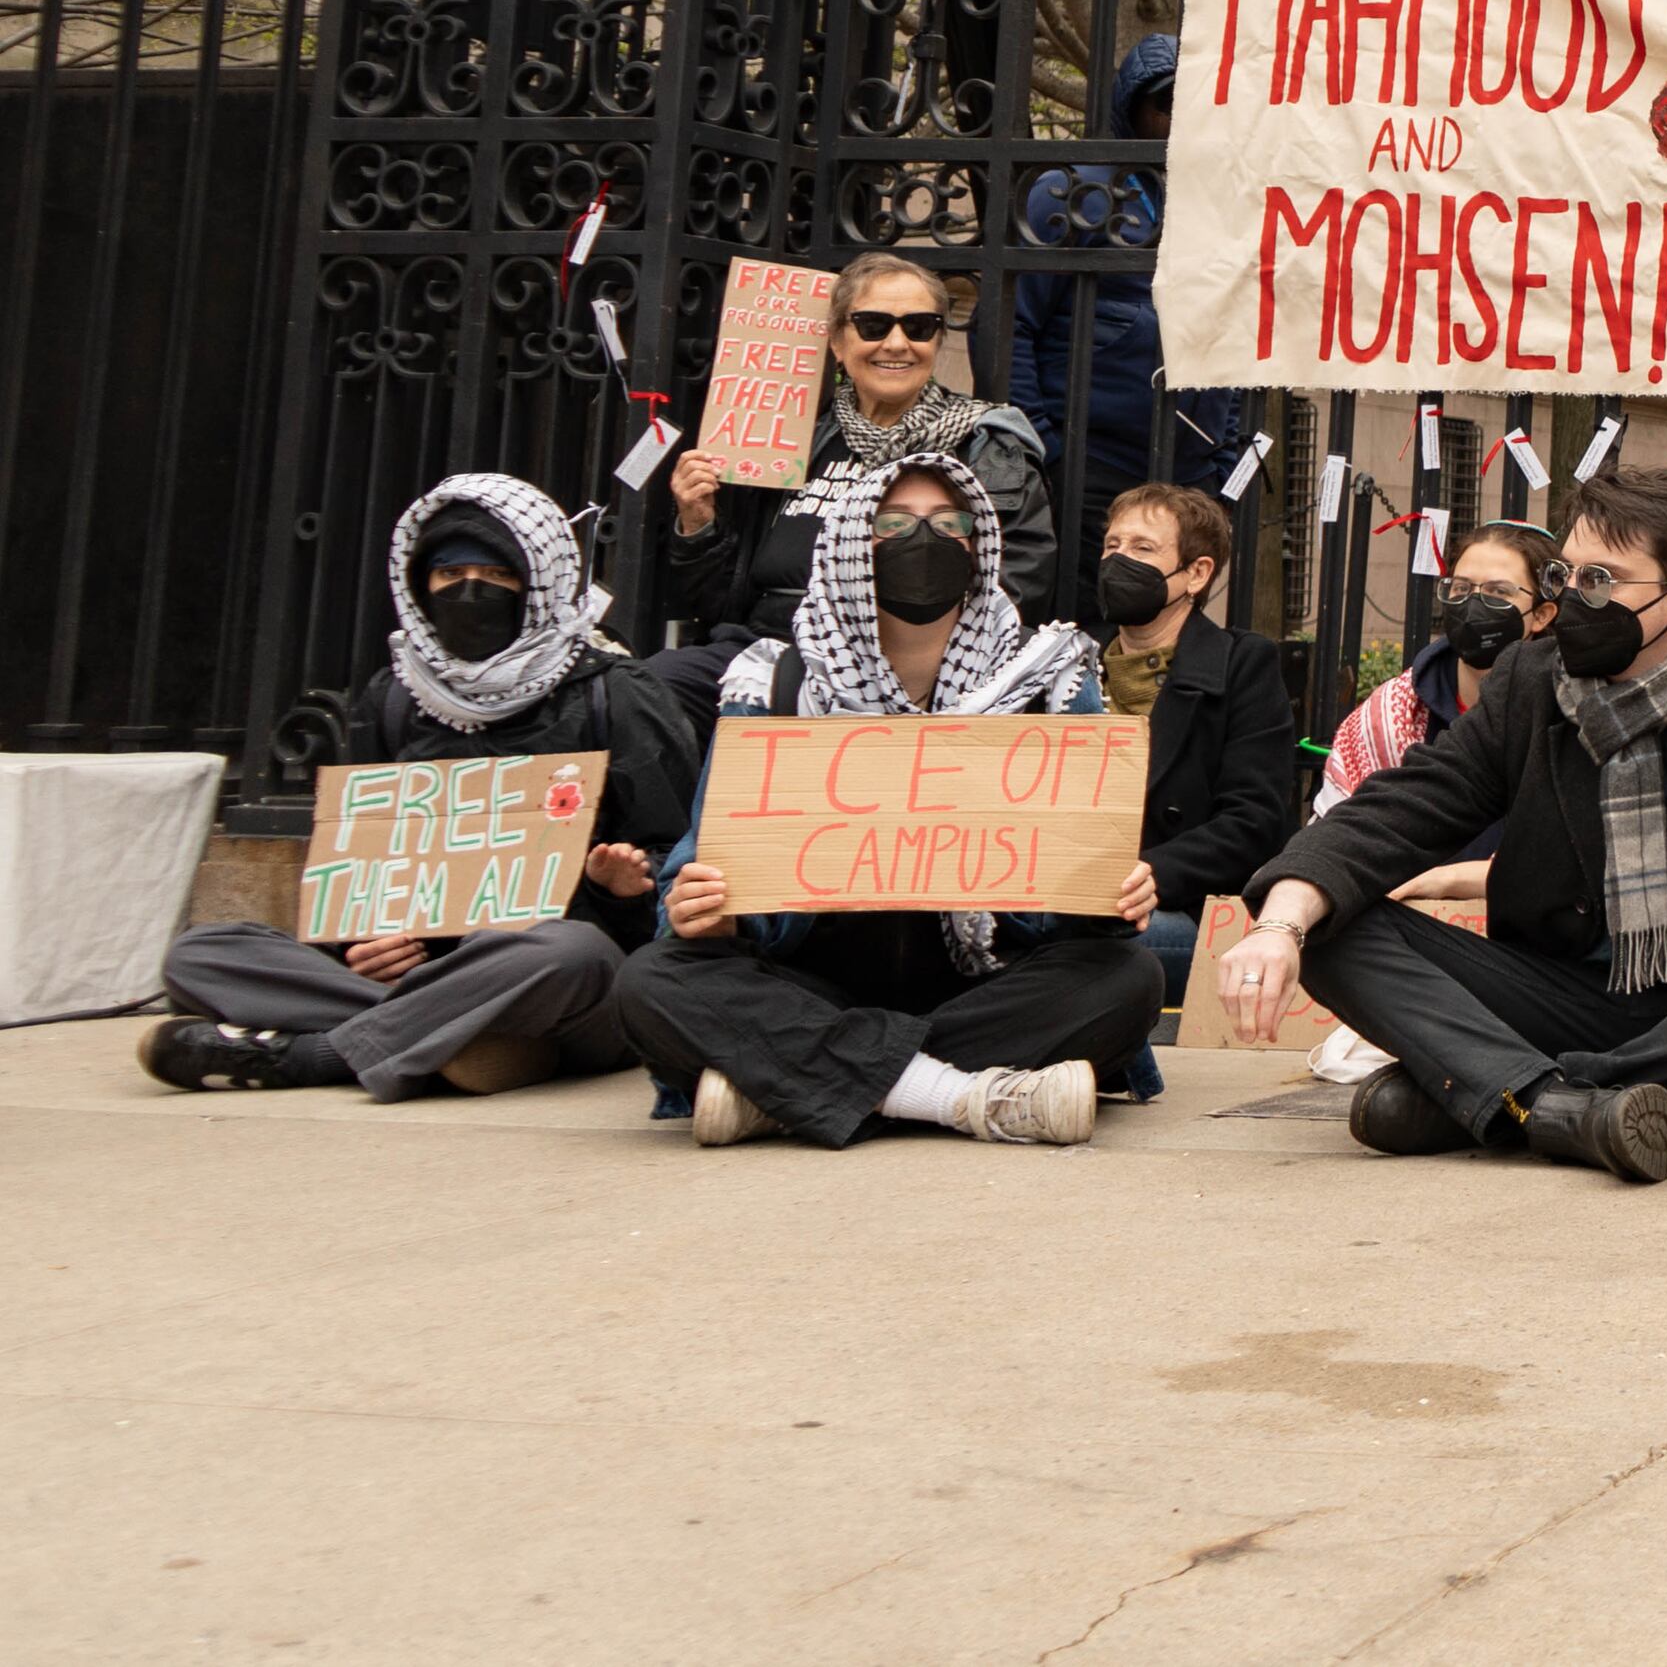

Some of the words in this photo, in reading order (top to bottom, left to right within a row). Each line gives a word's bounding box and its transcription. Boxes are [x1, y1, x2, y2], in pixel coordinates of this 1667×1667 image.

[1369, 117, 1462, 173] AND
[734, 262, 833, 300] FREE
[722, 308, 830, 336] PRISONERS
[755, 295, 801, 314] OUR
[717, 337, 818, 377] FREE
[710, 374, 809, 419] THEM
[705, 410, 799, 452] ALL
[729, 724, 970, 817] ICE
[1001, 725, 1137, 807] OFF
[334, 755, 534, 855] FREE
[795, 822, 1038, 895] CAMPUS!
[302, 857, 447, 939] THEM
[465, 852, 565, 926] ALL
